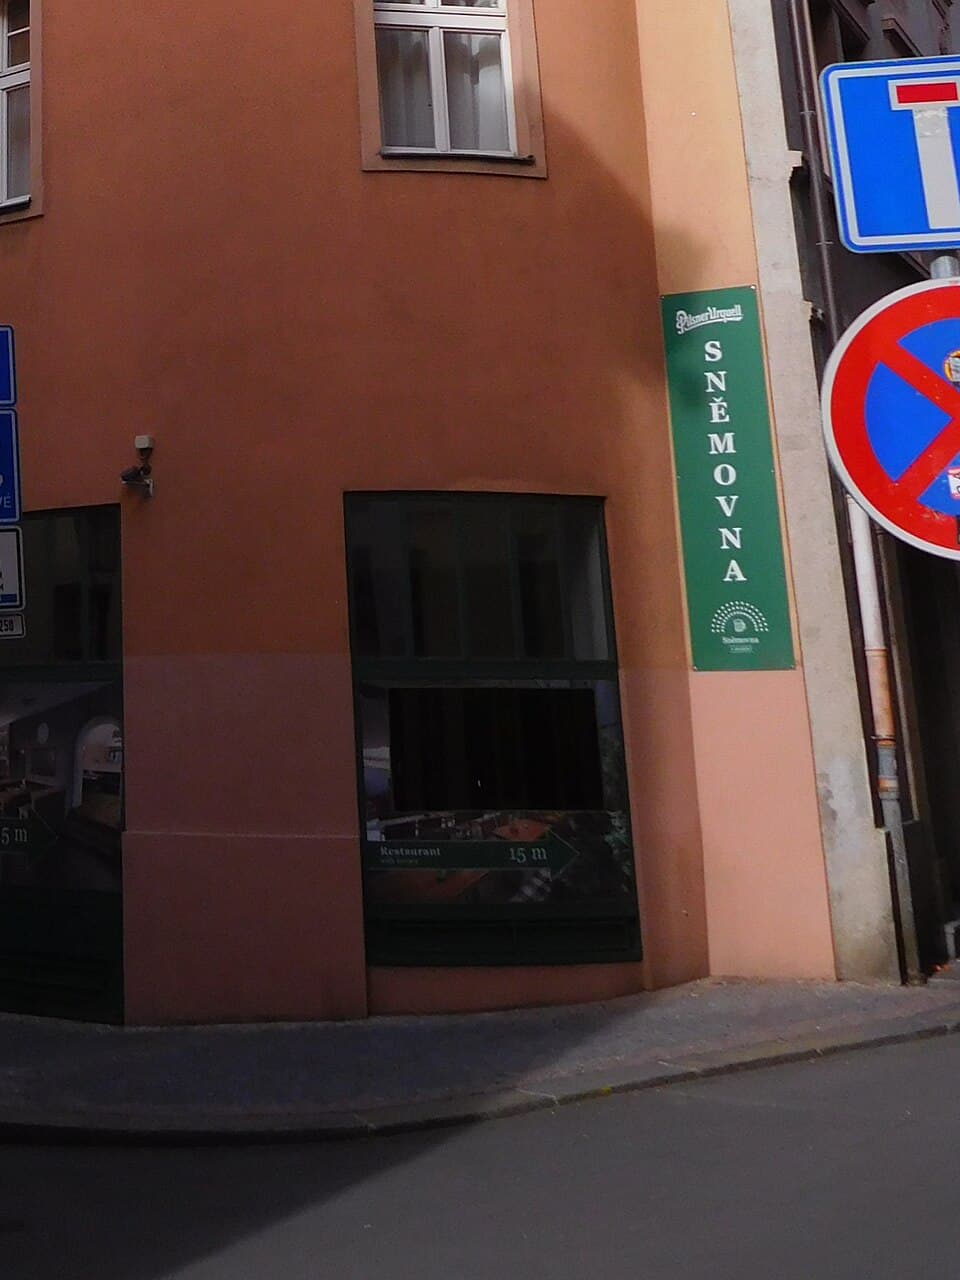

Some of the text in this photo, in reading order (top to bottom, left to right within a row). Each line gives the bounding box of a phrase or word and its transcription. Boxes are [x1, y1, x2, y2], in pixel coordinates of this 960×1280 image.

[676, 304, 744, 335] Pilsner Urquell
[703, 339, 747, 582] SNĚMOVNA
[13, 826, 29, 843] m
[380, 845, 548, 864] Restaurant 15 m
